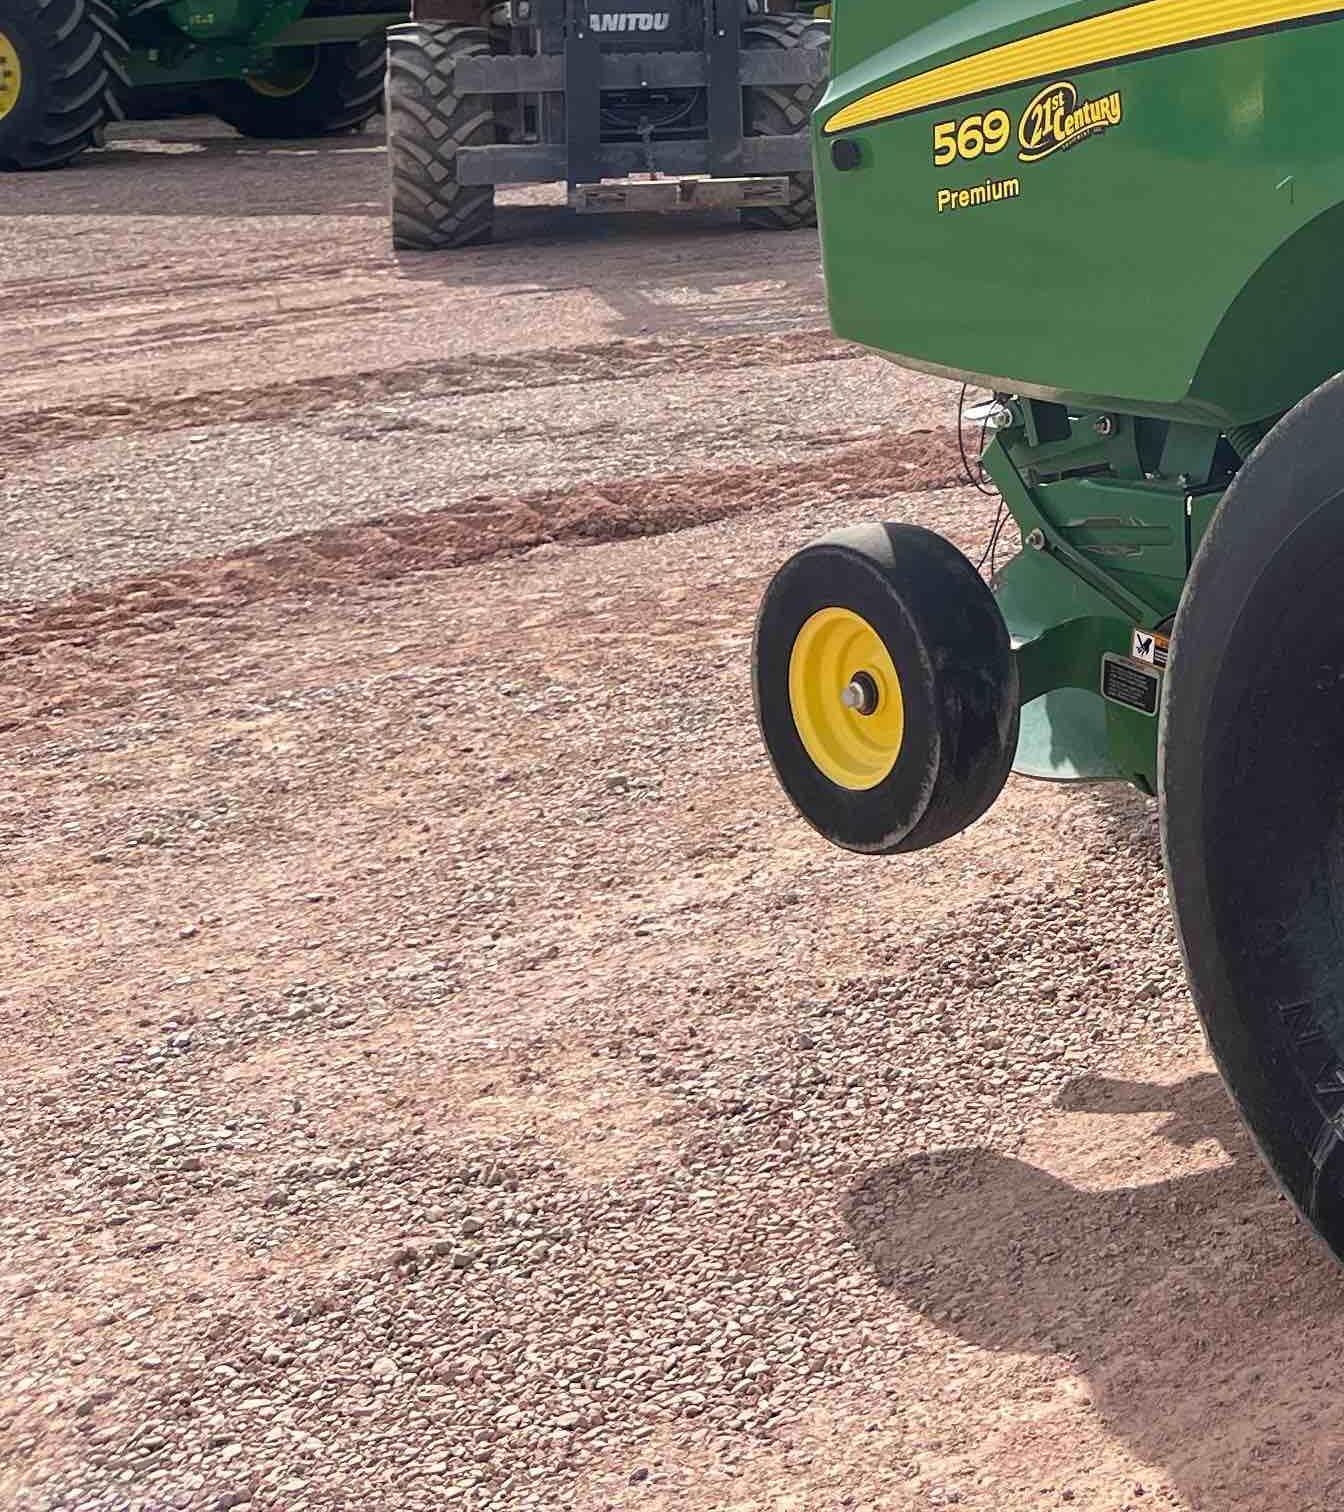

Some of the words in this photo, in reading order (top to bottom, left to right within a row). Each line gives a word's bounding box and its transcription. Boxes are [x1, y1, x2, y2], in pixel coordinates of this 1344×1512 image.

[588, 12, 670, 32] ANITOU
[933, 108, 1011, 167] 569
[1029, 90, 1066, 146] 21st
[1053, 92, 1121, 142] Century
[937, 177, 1020, 213] Premium
